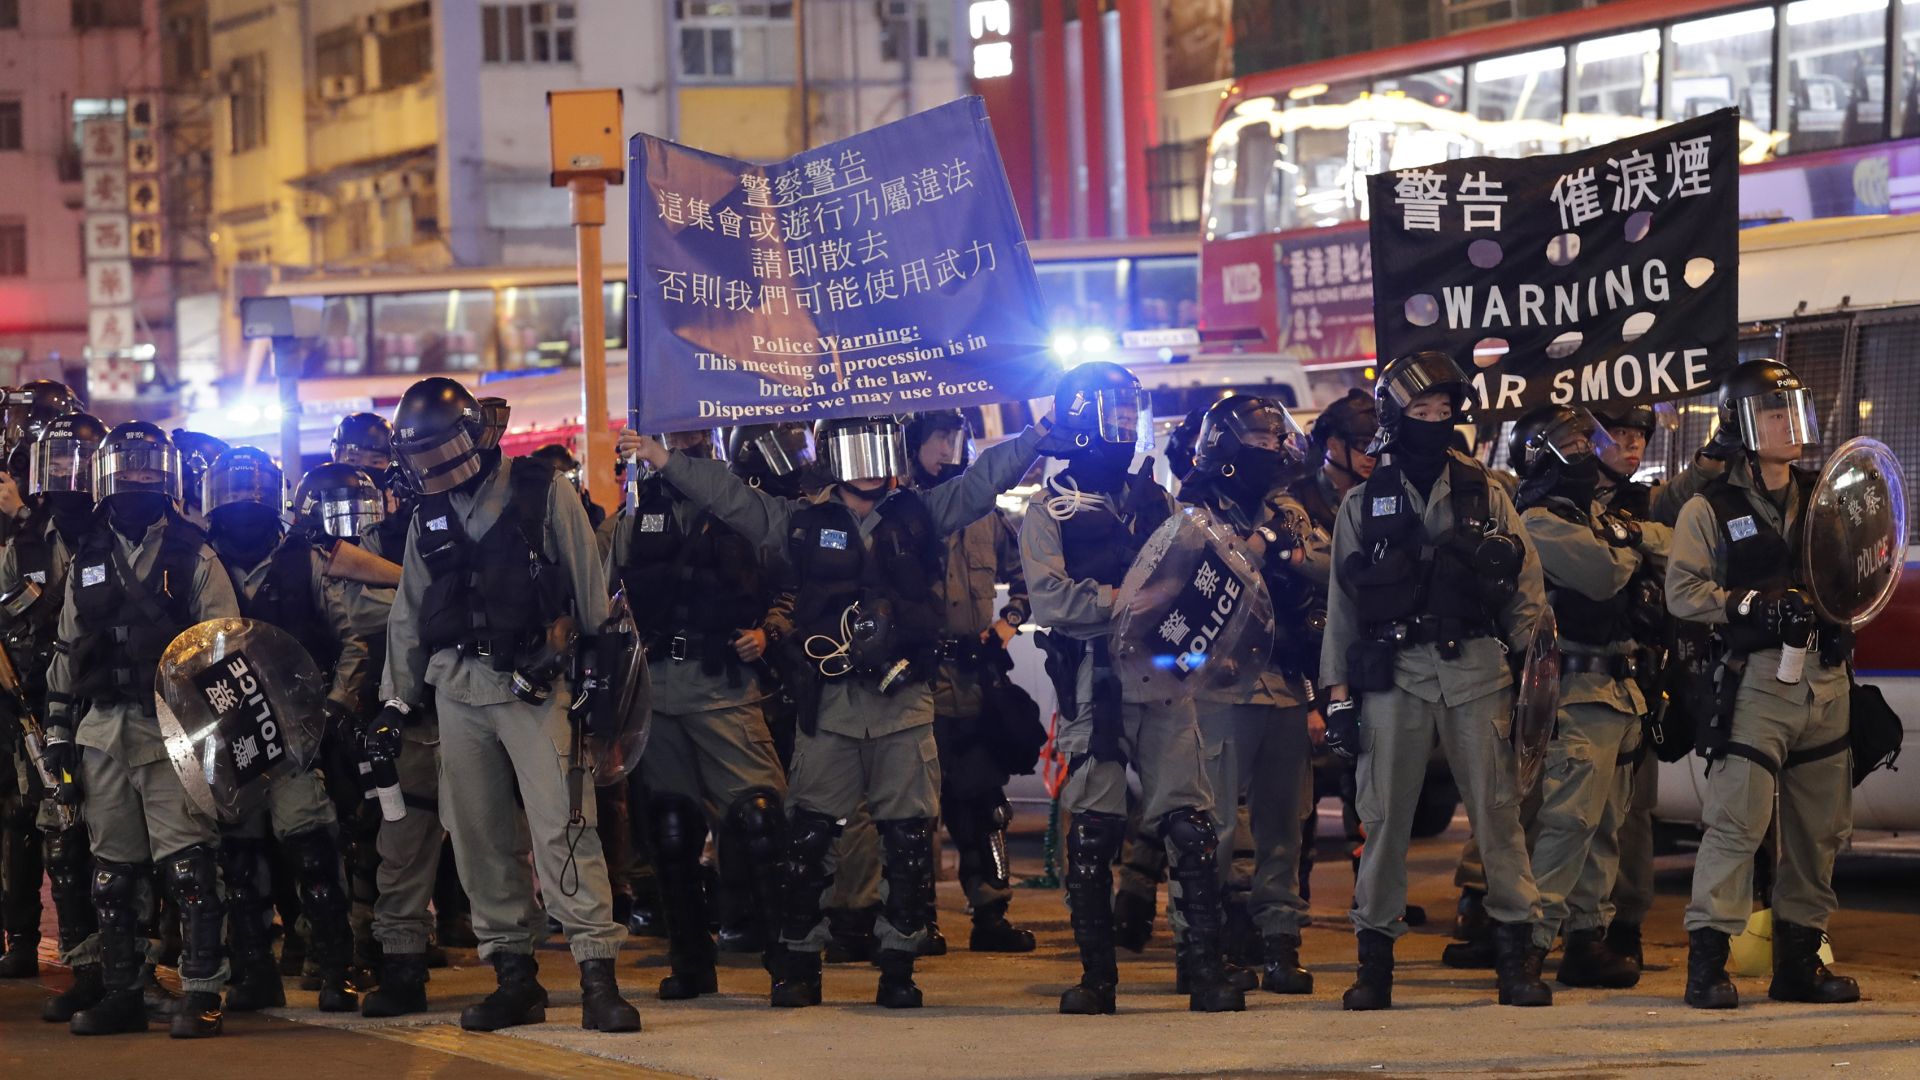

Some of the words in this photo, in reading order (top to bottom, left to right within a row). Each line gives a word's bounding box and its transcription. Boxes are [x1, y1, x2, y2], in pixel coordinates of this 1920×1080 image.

[658, 157, 974, 243] 這集會或遊行乃屬違法
[740, 149, 873, 207] 警察警告
[1393, 168, 1508, 232] 警告
[1549, 135, 1712, 230] 催淚煙
[657, 240, 996, 315] 否則我們可能使用武力
[751, 229, 889, 279] 請即散去
[1442, 258, 1670, 329] WARNING
[695, 352, 737, 371] This
[742, 360, 814, 380] meeting
[818, 362, 839, 375] or
[844, 347, 944, 375] procession
[948, 339, 964, 356] is
[967, 334, 988, 351] in
[752, 335, 813, 353] Police
[816, 325, 919, 351] Warning:
[698, 400, 785, 420] Disperse
[790, 402, 812, 414] or
[817, 396, 845, 410] we
[850, 391, 893, 404] may
[899, 386, 933, 400] use
[937, 379, 994, 396] force.
[759, 379, 826, 397] breach
[831, 376, 852, 393] of
[856, 375, 888, 389] the
[891, 370, 933, 385] law.
[1460, 372, 1527, 411] AR
[1550, 347, 1712, 405] SMOKE
[1776, 378, 1798, 388] Police
[49, 429, 73, 438] Police
[1848, 486, 1881, 527] 警察
[1856, 535, 1889, 584] POLICE
[1158, 560, 1222, 646] 警察
[1175, 576, 1241, 673] POLICE
[205, 678, 260, 771] 警察
[227, 657, 283, 761] POLICE
